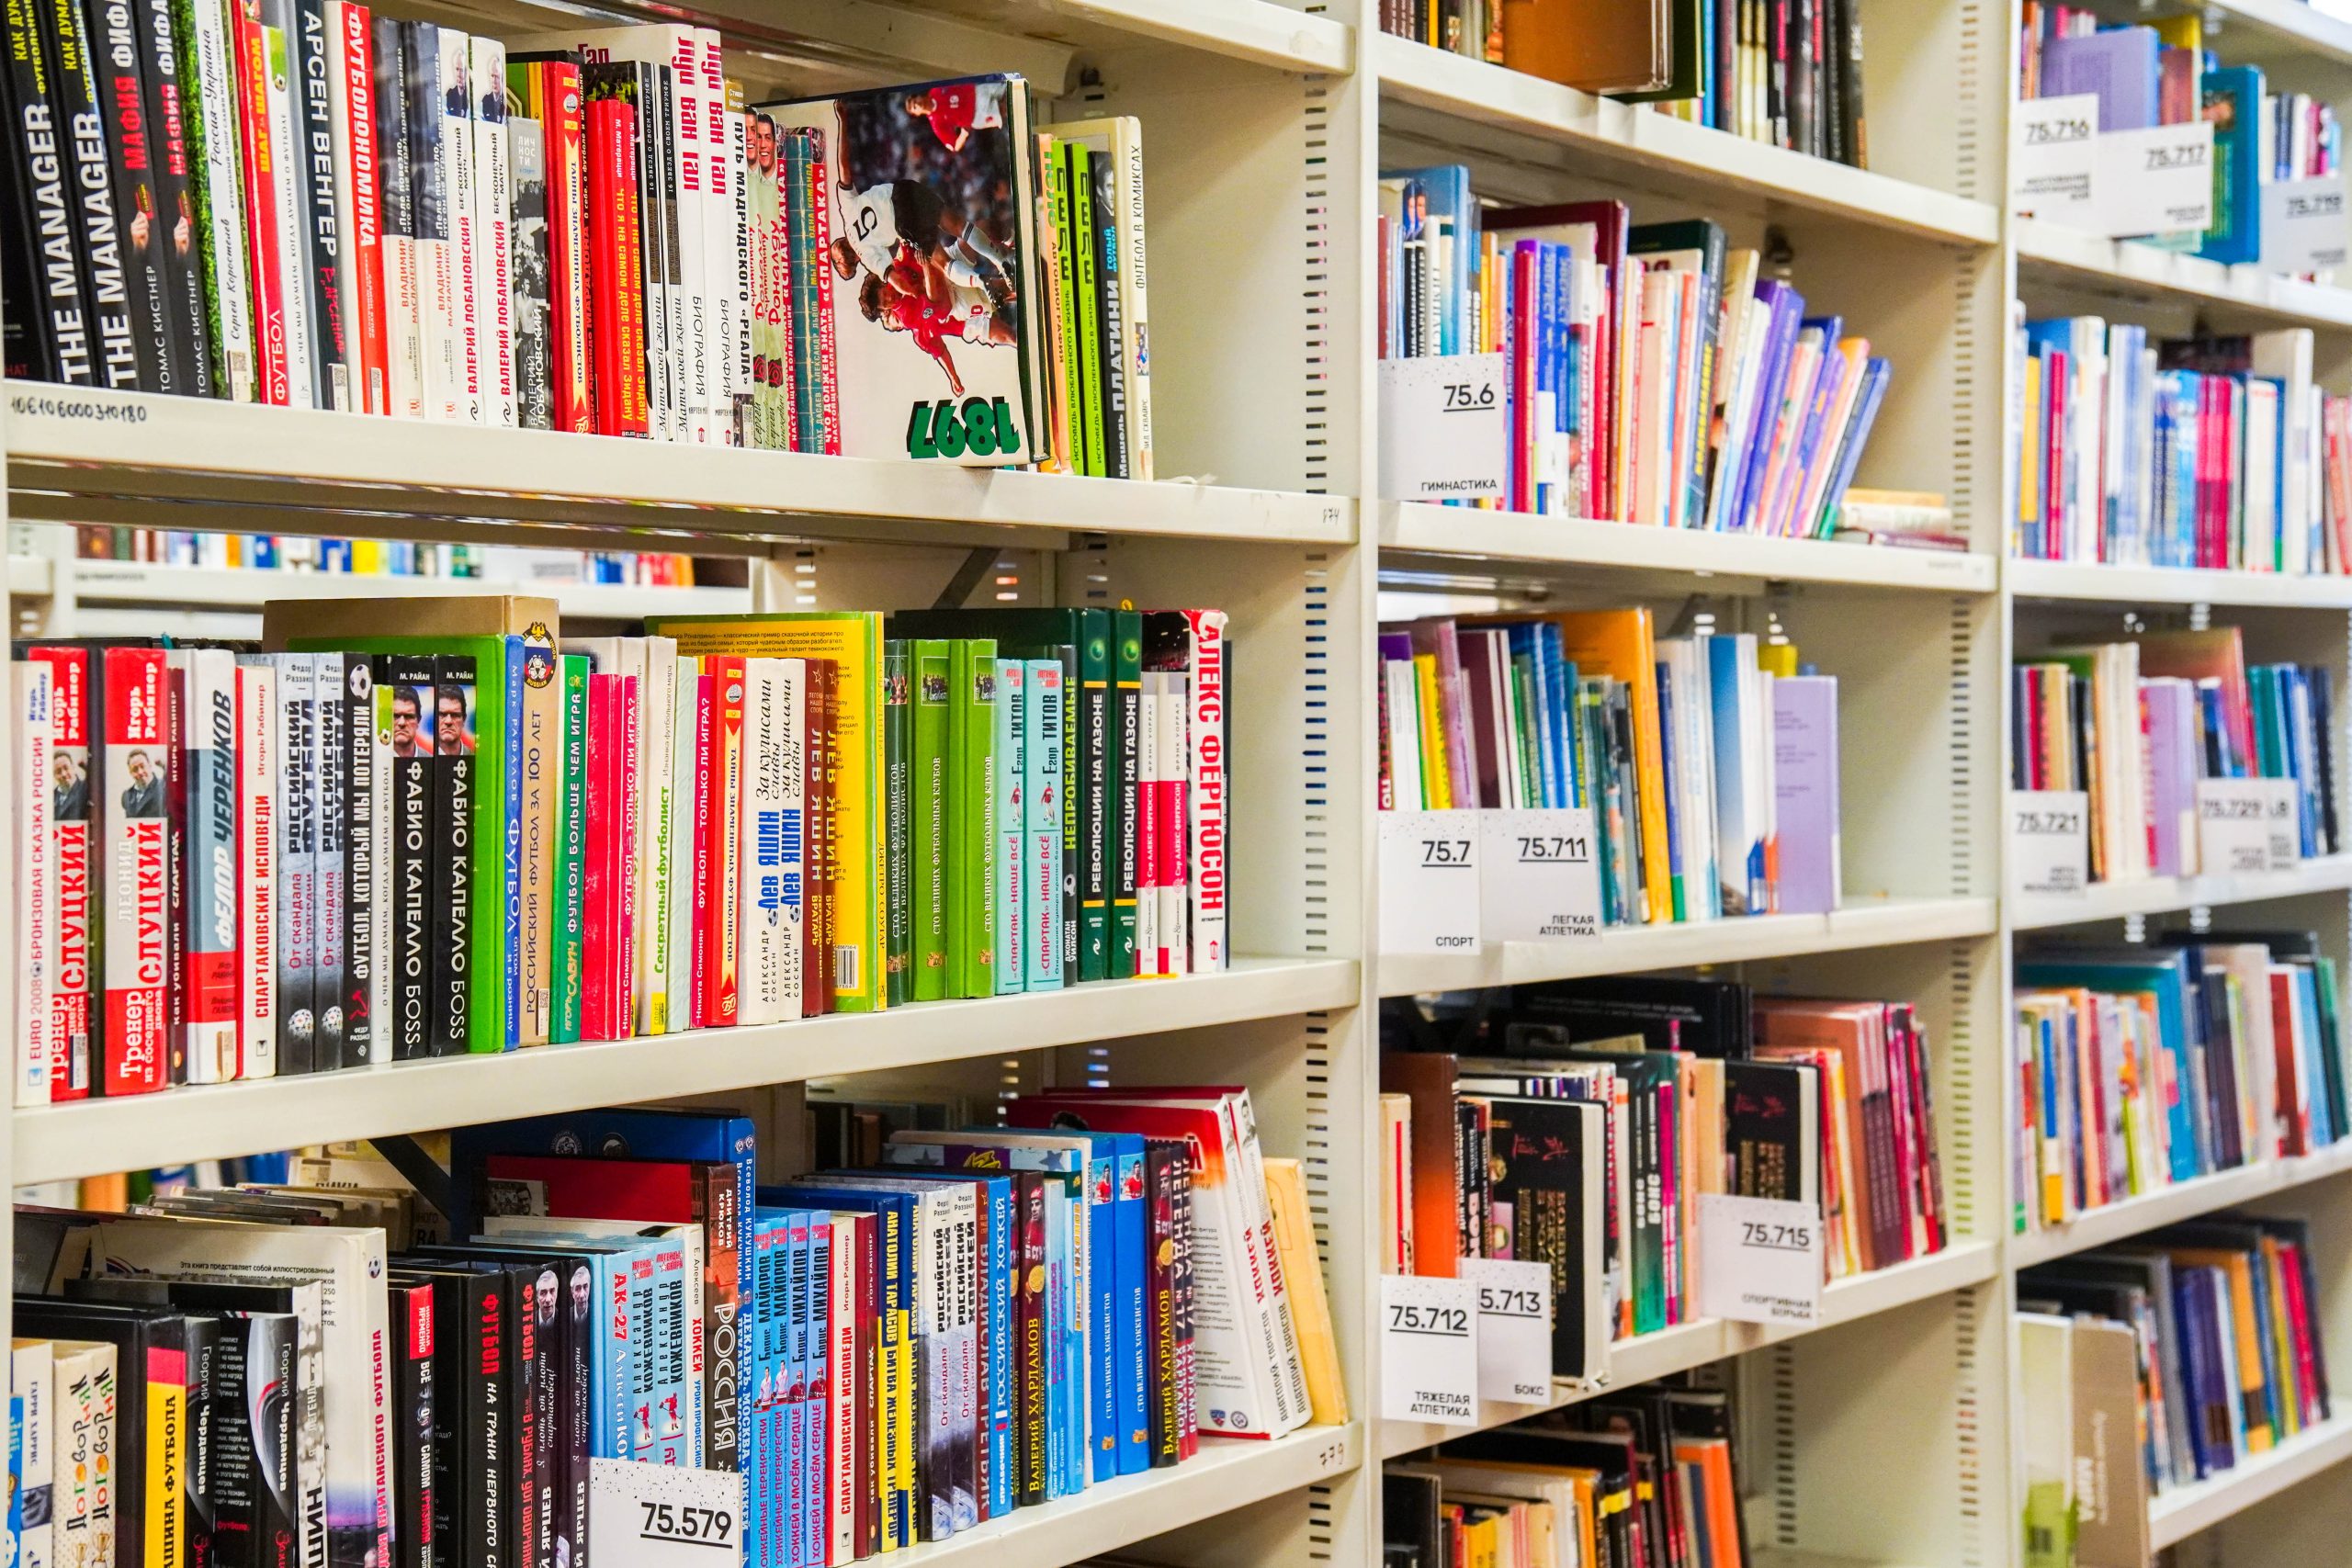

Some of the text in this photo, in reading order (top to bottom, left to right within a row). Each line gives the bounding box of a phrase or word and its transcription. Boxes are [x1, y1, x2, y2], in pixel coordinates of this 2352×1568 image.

[251, 38, 270, 173] ШАГ ШАГОМ
[304, 10, 329, 121] АРСЕН
[672, 36, 695, 85] Луи
[115, 76, 147, 170] МАФИЯ
[161, 85, 187, 175] МАФИЯ
[347, 12, 376, 246] ФУТБОЛОНОМИКА
[680, 96, 697, 141] ван
[312, 131, 337, 256] ВЕНГЕР
[454, 127, 465, 210] БЕСКОНЕЧНЫЙ
[1131, 145, 1144, 218] КОМИКСАХ
[24, 104, 90, 383] THE MANAGER
[74, 112, 137, 388] THE MANAGER
[399, 239, 409, 308] ВЛАДИМИР
[735, 121, 751, 385] ПУТЬ МАДРИДСКОГО «РЕАЛА»
[818, 168, 830, 302] «СПАРТАКА»
[1134, 237, 1146, 289] ФУТБОЛ
[146, 265, 172, 393] ТОМАС КИСТНЕР
[459, 217, 478, 394] ВАЛЕРИЙ ЛОБАНОВСКИЙ
[494, 221, 511, 396] ВАЛЕРИЙ ЛОБАНОВСКИЙ
[693, 296, 706, 396] БИОГРАФИЯ
[269, 310, 287, 400] ФУТБОЛ
[526, 355, 537, 426] ВАЛЕРИЙ
[532, 309, 547, 426] ЛОБАНОВСКИЙ
[821, 354, 830, 413] ДОЛЖЕН
[1106, 280, 1128, 478] Мишель ПЛАТИНИ
[1442, 383, 1496, 407] 75.6
[906, 396, 1022, 459] 1897
[1420, 479, 1498, 491] ГИМНАСТИКА
[128, 686, 141, 739] Игорь
[145, 662, 158, 739] Рабинер
[1042, 694, 1057, 740] ТИТОВ
[212, 689, 232, 843] ЧЕРЕНКОВ
[285, 700, 301, 854] РОССИЙСКИЙ
[698, 697, 710, 908] ФУТБОЛ ТОЛЬКО ЛИ ИГРА?
[811, 728, 822, 881] ЛЕВ ЯШИН
[1065, 676, 1076, 851] НЕПРОБИВАЕМЫЕ
[1091, 694, 1102, 893] РЕВОЛЮЦИИ НА ГАЗОНЕ
[1198, 625, 1224, 909] АЛЕКС ФЕРГЮСОН
[350, 705, 371, 980] ФУТБОЛ, КОТОРЫЙ МЫ ПОТЕРЯЛИ
[567, 694, 582, 934] ФУТБОЛ БОЛЬШЕ ЧЕМ ИГРА
[758, 811, 780, 866] ЯШИН
[781, 808, 801, 864] ЯШИН
[1039, 835, 1050, 860] ВСЁ
[1421, 840, 1471, 863] 75.7
[1517, 837, 1588, 858] 75.711
[29, 736, 44, 1060] EURO 2008 БРОНЗОВАЯ СКАЗКА РОССИИ
[127, 822, 163, 985] СЛУЦКИЙ
[255, 795, 269, 1019] СПАРТАКОВСКИЕ ИСПОВЕДИ
[290, 873, 301, 942] скандала
[405, 761, 423, 977] ФАБИО КАПЕЛЛО
[451, 760, 468, 973] ФАБИО КАПЕЛЛО
[526, 711, 541, 1014] РОССИЙСКИЙ ФУТБОЛ ЗА 100 ЛЕТ
[1041, 863, 1050, 902] НАШЕ
[654, 879, 666, 974] Секретный
[1435, 936, 1475, 947] СПОРТ
[1539, 926, 1596, 936] АТЛЕТИКА
[1551, 915, 1595, 925] ЛЕГКАЯ
[120, 990, 146, 1078] Тренер
[886, 1211, 899, 1348] АНАТОЛИЙ ТАРАСОВ
[1742, 1222, 1810, 1247] 75.715
[613, 1271, 628, 1341] АК-27
[770, 1249, 787, 1319] МАЙОРОВ
[810, 1247, 828, 1323] МИХАЙЛОВ
[934, 1227, 945, 1334] РОССИЙСКИЙ
[995, 1197, 1007, 1408] РОССИЙСКИЙ ХОККЕЙ
[1389, 1305, 1468, 1332] 75.712
[1479, 1288, 1541, 1313] 5.713
[481, 1292, 500, 1375] ФУТБОЛ
[692, 1317, 703, 1372] ХОККЕЙ
[1160, 1289, 1173, 1455] ВАЛЕРИЙ ХАРЛАМОВ
[198, 1346, 212, 1495] Георгий Черданцев
[790, 1408, 801, 1451] СЕРДЦЕ
[841, 1326, 853, 1516] СПАРТАКОВСКИЕ ИСПОВЕДИ
[1028, 1318, 1040, 1493] ВАЛЕРИЙ ХАРЛАМОВ
[1410, 1404, 1470, 1417] АТЛЕТИКА
[1414, 1391, 1470, 1404] ТЯЖЕЛАЯ
[1514, 1384, 1544, 1396] БОКС
[164, 1395, 176, 1494] ФУТБОЛА
[640, 1501, 732, 1540] 75.579
